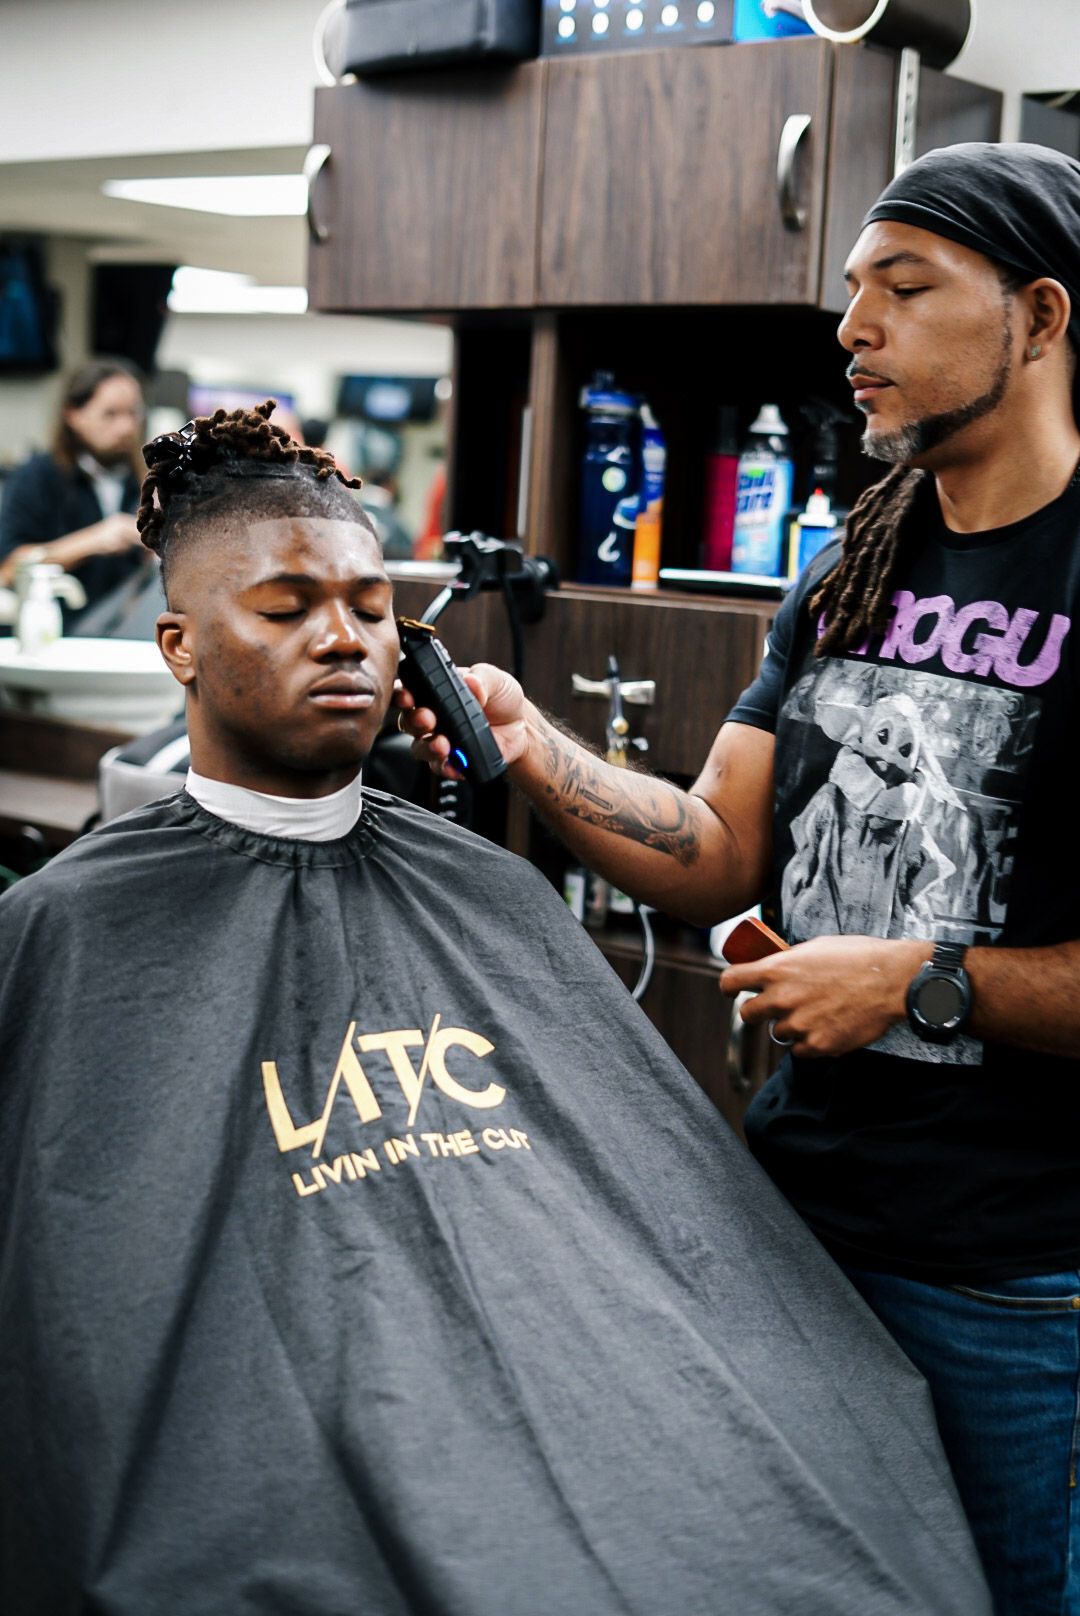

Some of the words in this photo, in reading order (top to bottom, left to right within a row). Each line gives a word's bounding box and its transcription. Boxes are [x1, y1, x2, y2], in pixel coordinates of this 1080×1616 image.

[817, 590, 1072, 687] ROGU
[292, 1148, 381, 1197] LIVIN
[384, 1133, 421, 1165] IN
[420, 1128, 480, 1158] THE
[482, 1127, 531, 1151] CUT
